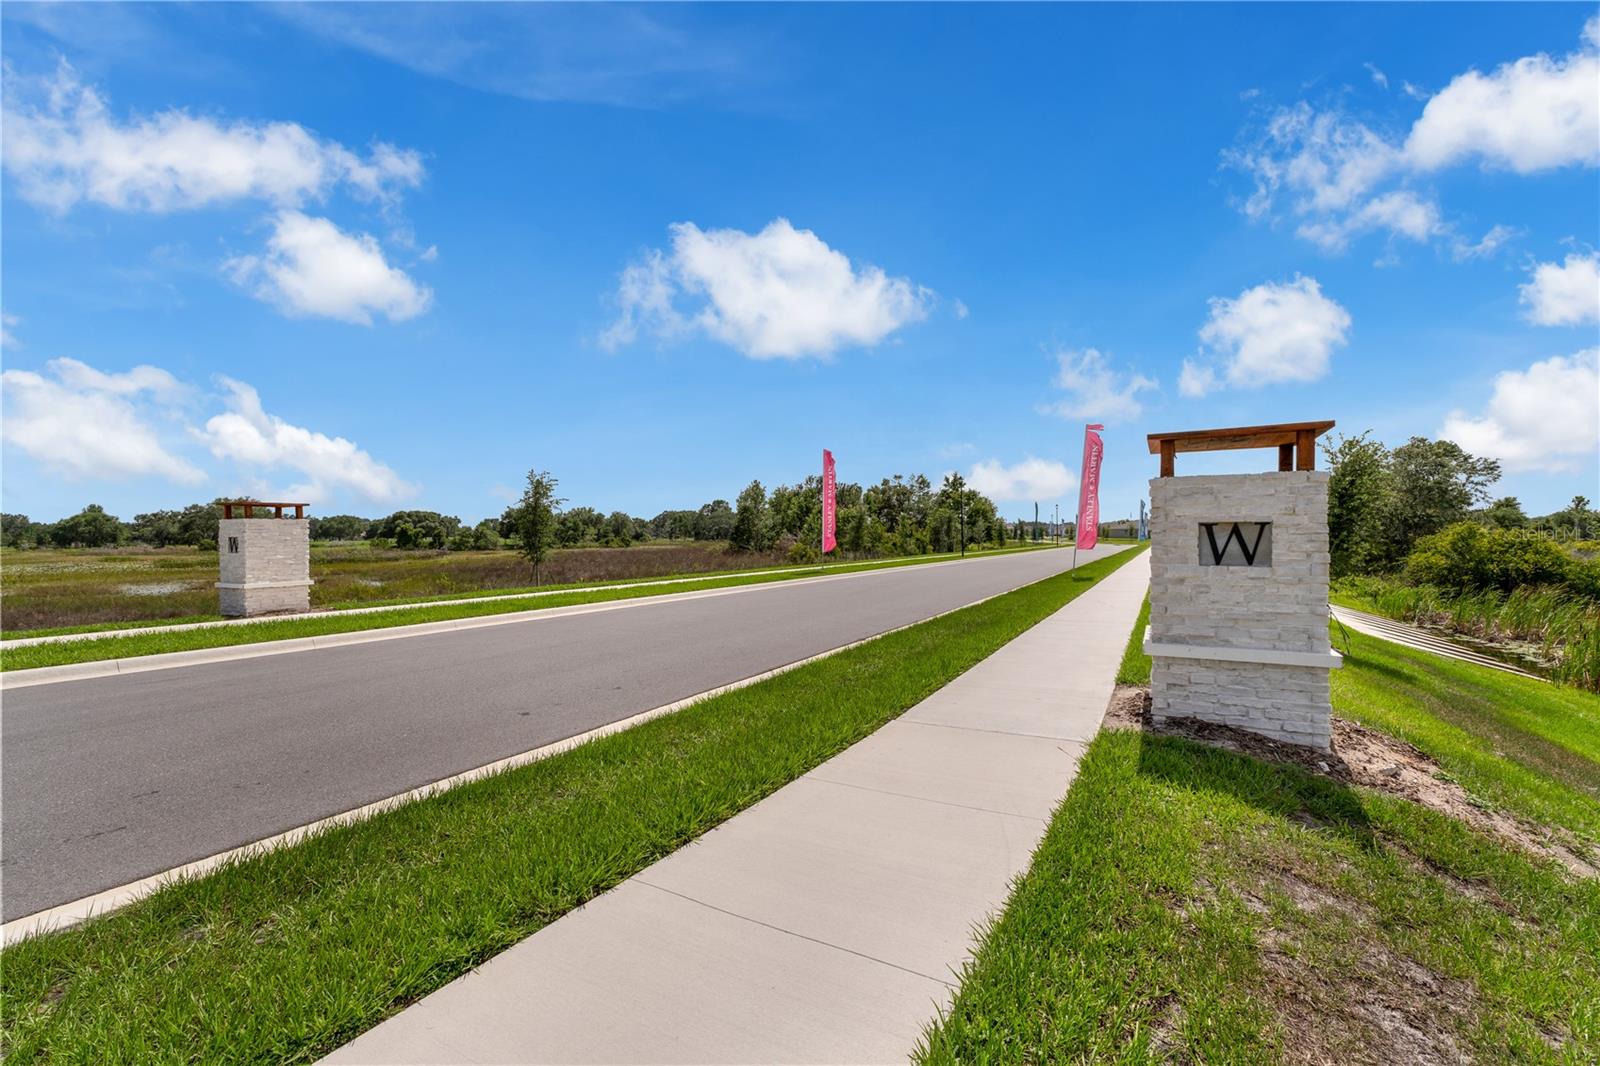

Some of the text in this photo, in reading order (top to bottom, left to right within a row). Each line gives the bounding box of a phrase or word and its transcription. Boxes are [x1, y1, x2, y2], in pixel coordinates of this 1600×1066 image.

[1086, 445, 1099, 532] STANLEY MARTIN
[228, 536, 239, 553] W
[1198, 522, 1272, 566] W
